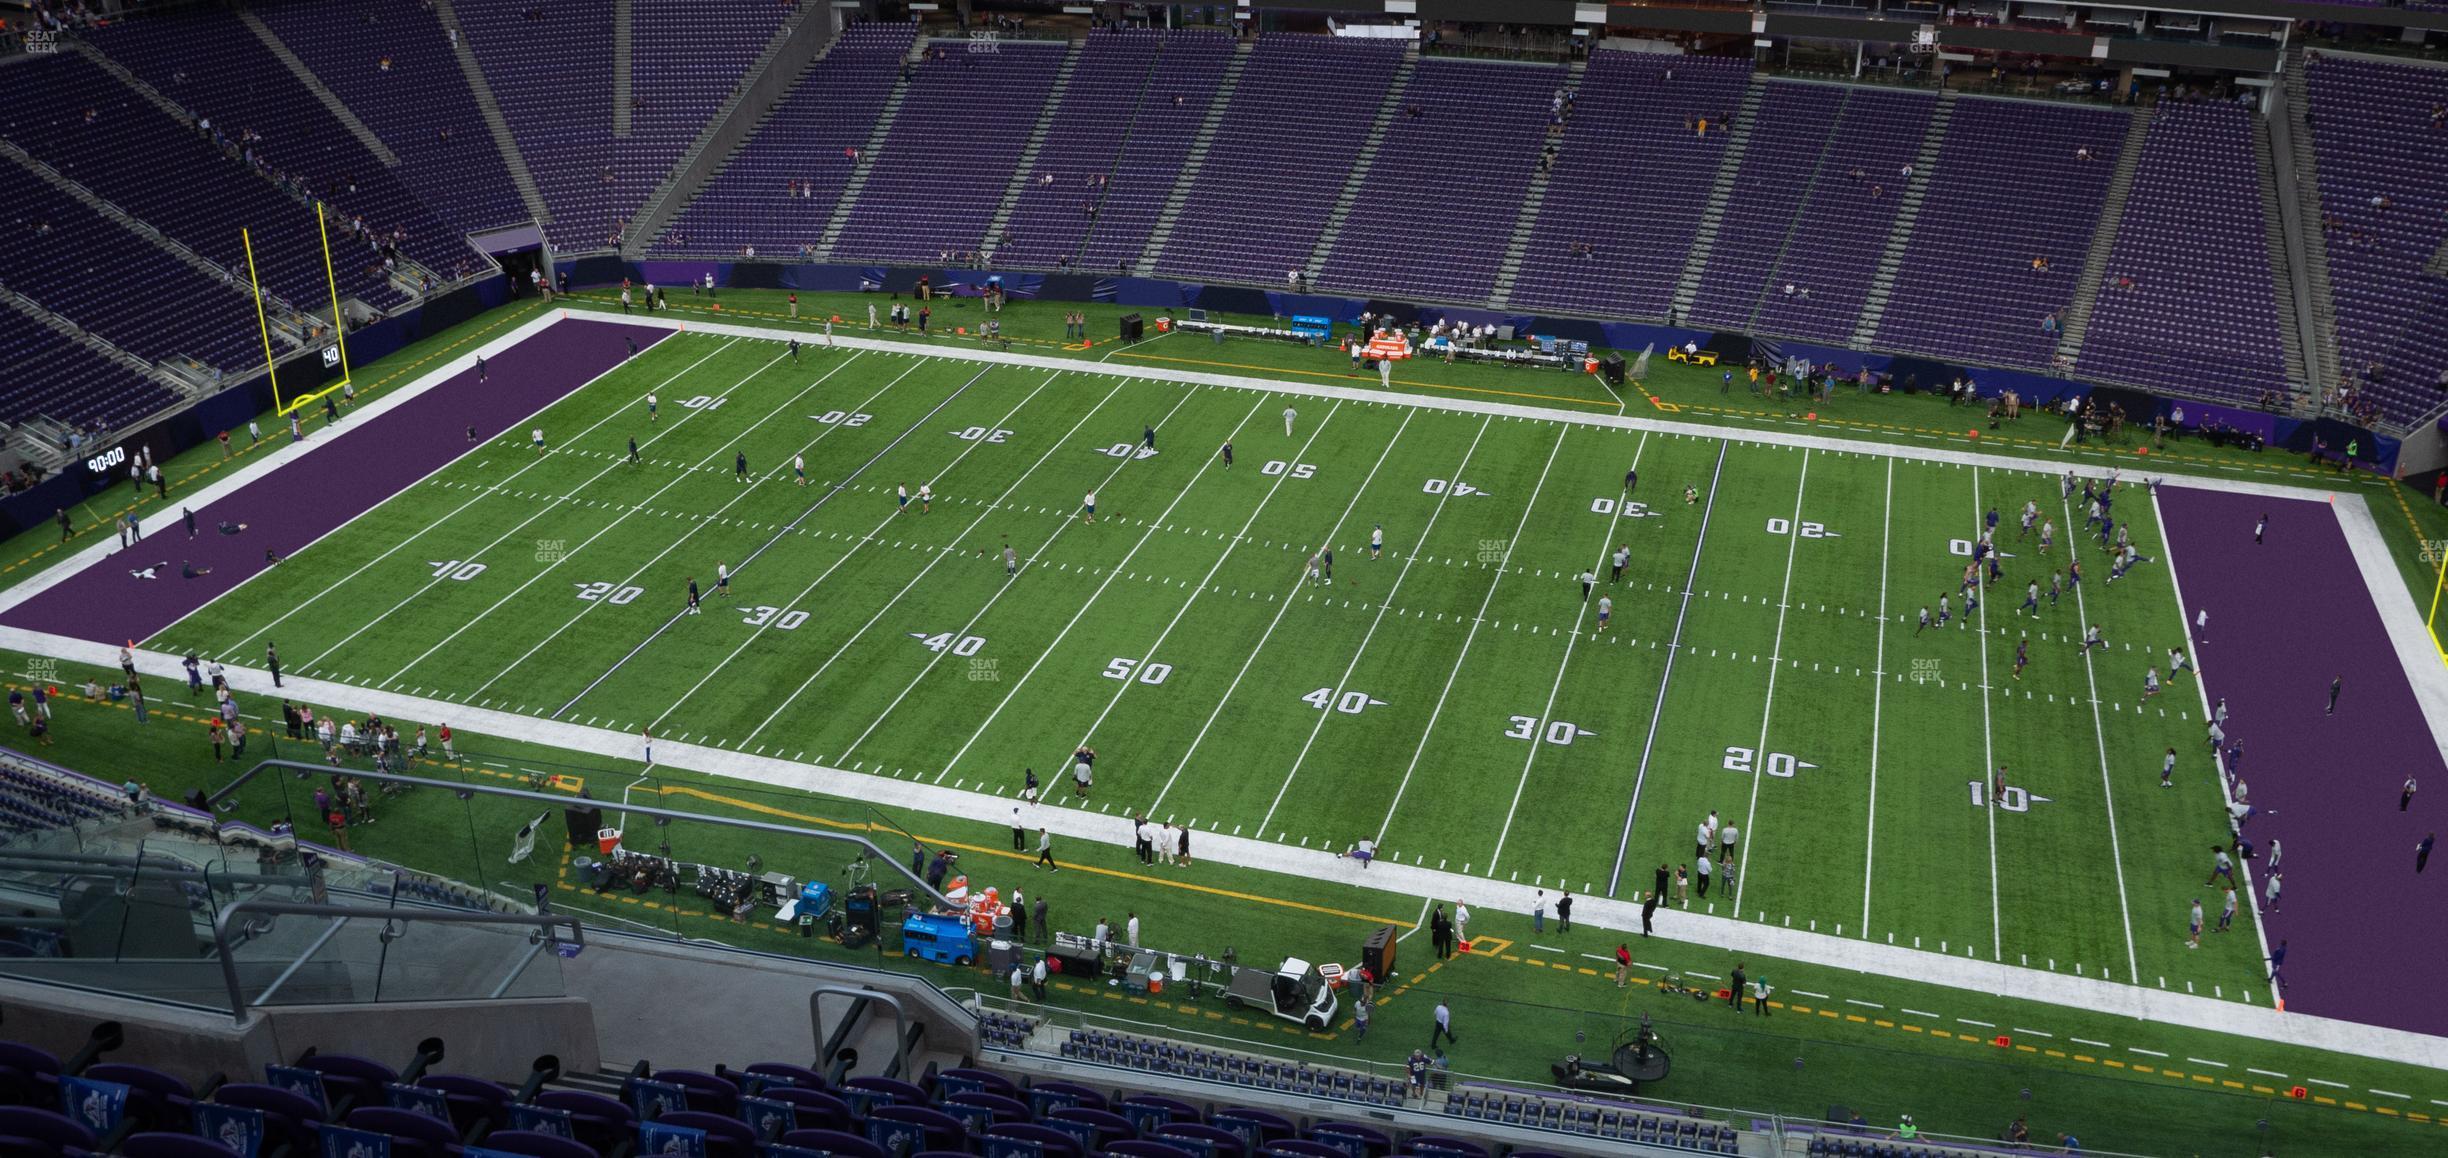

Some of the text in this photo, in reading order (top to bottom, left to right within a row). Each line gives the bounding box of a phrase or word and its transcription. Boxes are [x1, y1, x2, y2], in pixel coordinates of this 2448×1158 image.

[323, 346, 338, 362] 40
[682, 396, 728, 411] 10
[817, 410, 873, 427] 20
[958, 426, 1014, 443] 30
[88, 447, 124, 472] 90:00
[1259, 460, 1317, 480] 50
[1422, 479, 1477, 497] 40
[1590, 498, 1648, 517] 30
[1766, 518, 1825, 537] 20
[438, 560, 488, 581] 10
[575, 581, 644, 605] 20
[741, 605, 810, 630] 30
[922, 631, 987, 657] 40
[1102, 657, 1173, 685] 50
[1301, 687, 1370, 714] 40
[1504, 715, 1576, 745] 30
[1722, 746, 1796, 778] 20
[1968, 780, 2030, 812] 10
[1413, 1061, 1425, 1072] 26
